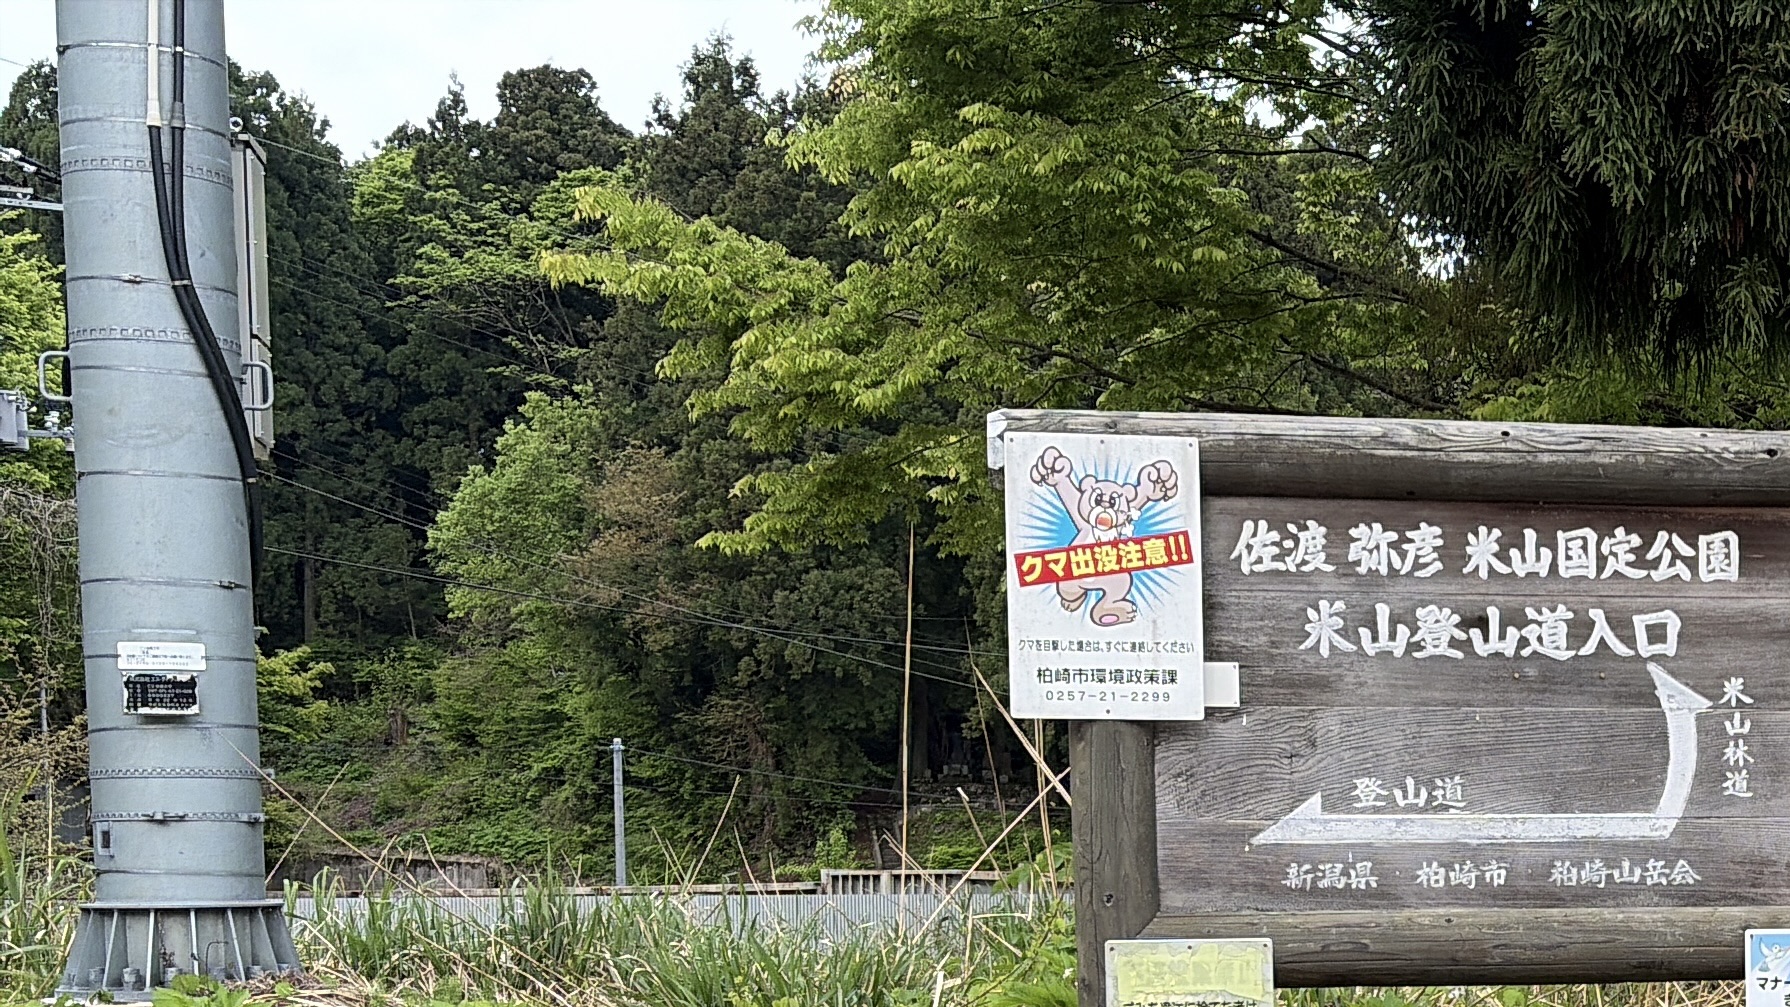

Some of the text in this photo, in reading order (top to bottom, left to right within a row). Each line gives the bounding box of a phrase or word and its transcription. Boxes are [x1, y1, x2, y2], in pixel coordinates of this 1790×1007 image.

[1021, 534, 1189, 583] クマ出没注意!!
[1231, 519, 1740, 584] 佐渡 弥彦 米山国定公園
[1299, 599, 1682, 660] 米山登山道入口
[1036, 667, 1179, 686] 柏崎市環境政策課
[1045, 690, 1171, 703] 0257-21-2299
[1718, 676, 1755, 799] 米山林道
[1351, 776, 1467, 809] 登山道
[1281, 857, 1702, 891] 新潟県 柏崎市 柏崎山岳会
